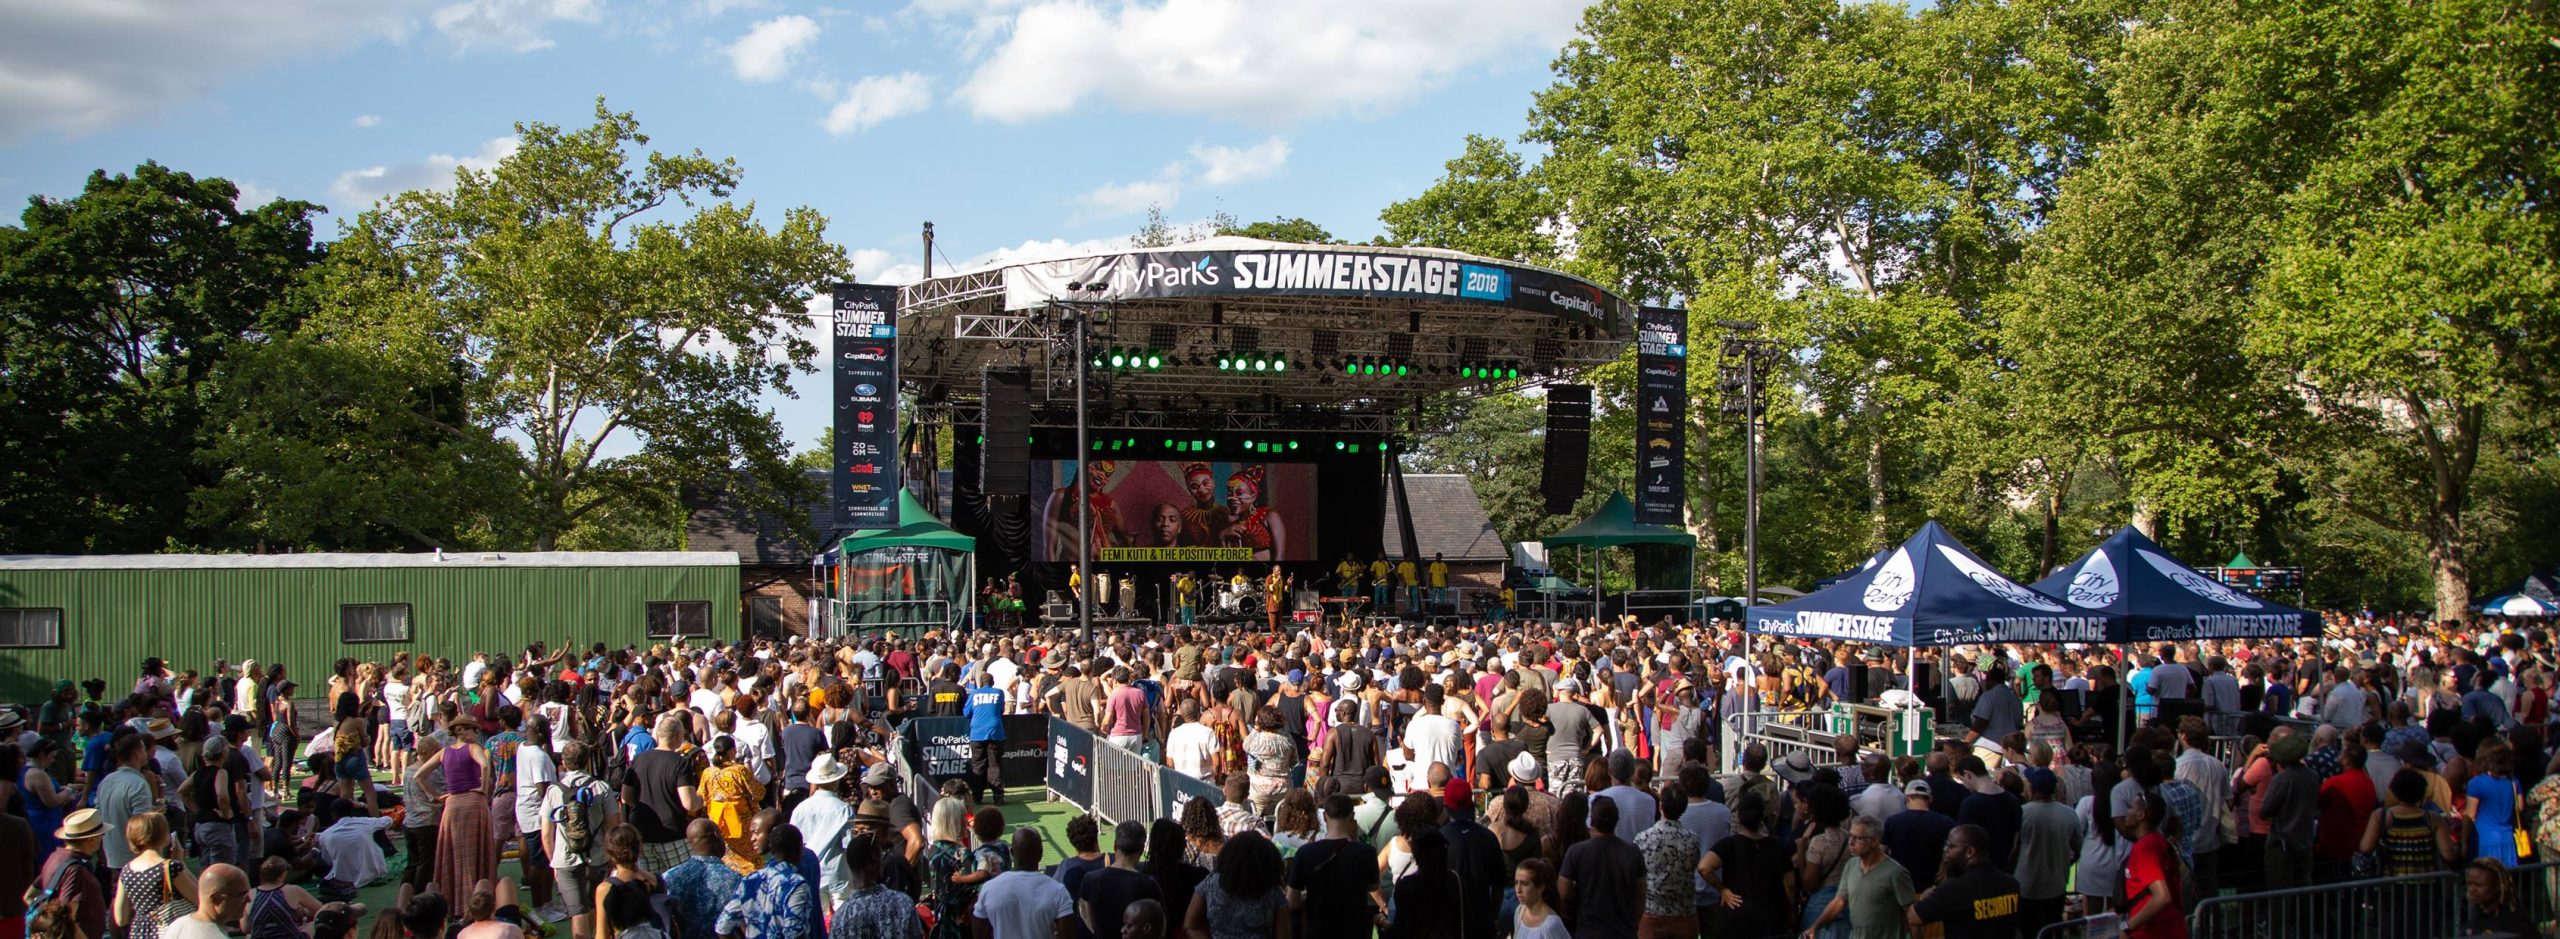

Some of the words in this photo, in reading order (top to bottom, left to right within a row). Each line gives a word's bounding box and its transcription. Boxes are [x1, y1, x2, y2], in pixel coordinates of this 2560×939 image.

[1233, 254, 1459, 296] SUMMERSTAGE
[1467, 272, 1499, 293] 2018
[1520, 286, 1541, 296] PRESENTED
[834, 309, 886, 324] SUMMER
[836, 324, 873, 337] STAGE
[1639, 330, 1678, 344] SUMMER
[1640, 342, 1668, 355] STAGE
[1102, 549, 1124, 560] FEMI
[1127, 549, 1148, 560] KUTI
[1150, 549, 1157, 560] &
[1160, 549, 1176, 560] THE
[1179, 549, 1219, 560] POSITIVE
[1221, 549, 1249, 560] FORCE
[1872, 571, 1907, 587] City
[1969, 571, 2013, 592] City
[2072, 572, 2112, 588] City
[2170, 572, 2212, 590] City
[1796, 611, 1895, 642] SUMMERSTAGE
[1986, 617, 2108, 641] SUMMERSTAGE
[2194, 614, 2302, 637] SUMMERSTAGE
[973, 693, 1000, 706] STAFF
[923, 744, 972, 760] SUMME
[929, 760, 967, 776] STAGE
[1974, 894, 2018, 920] SECURITY
